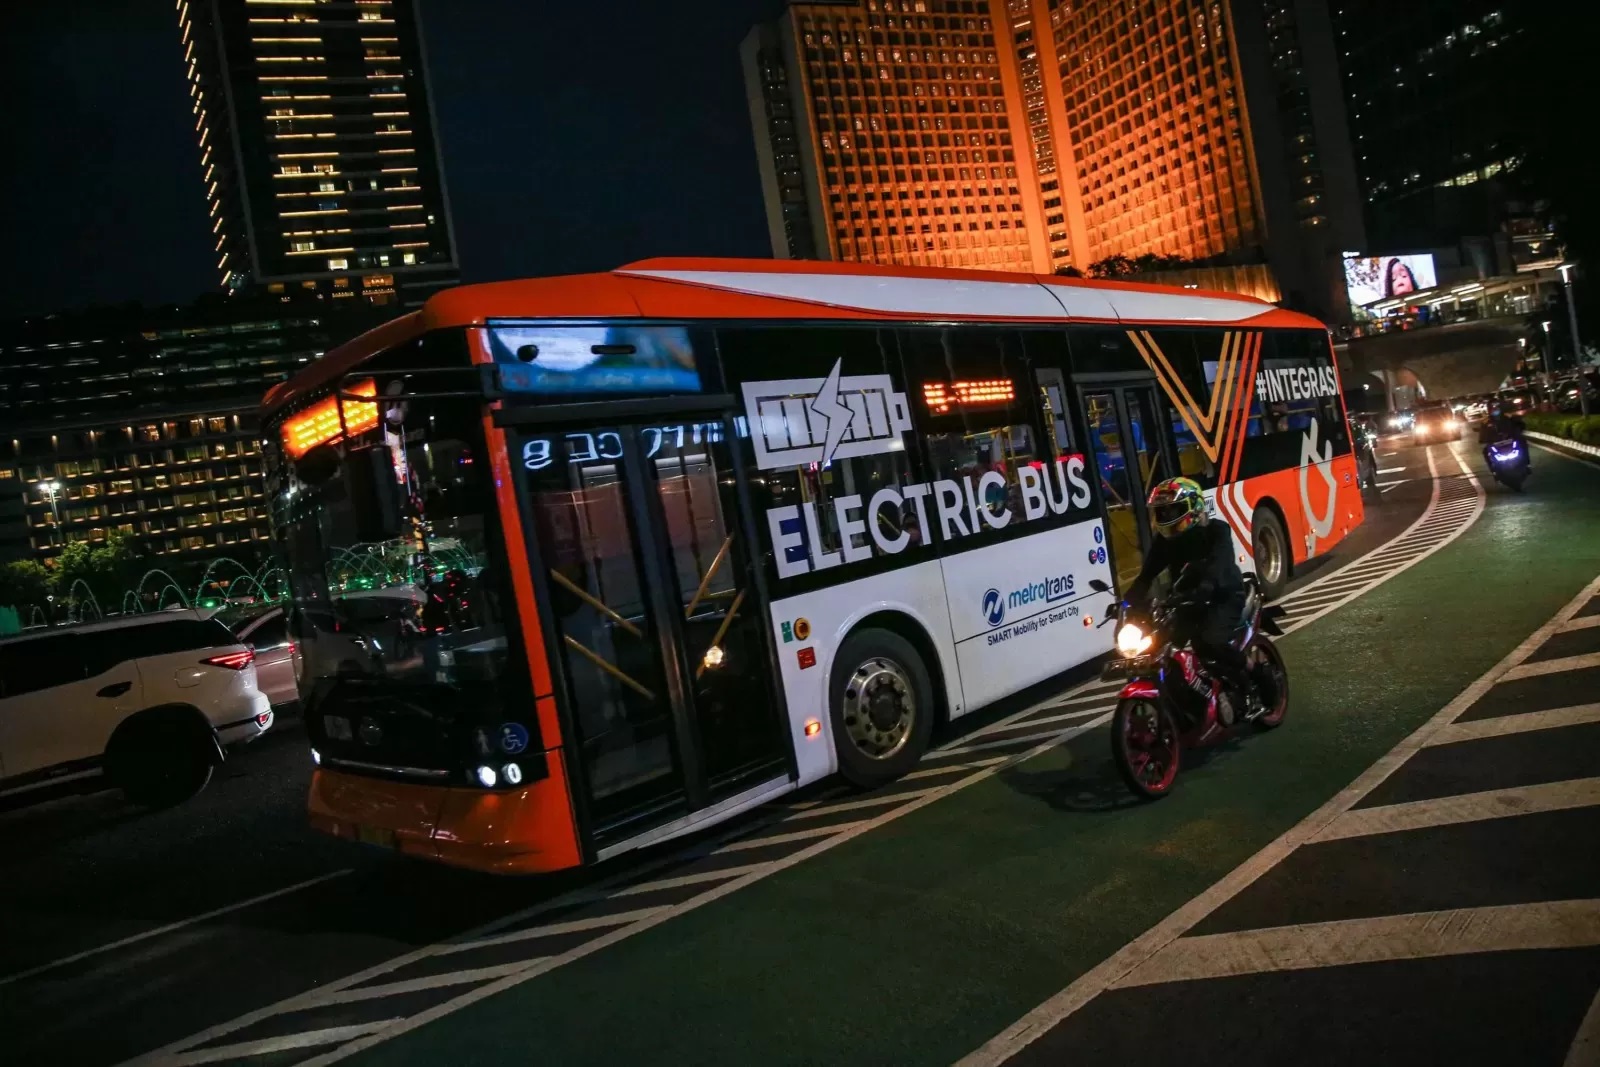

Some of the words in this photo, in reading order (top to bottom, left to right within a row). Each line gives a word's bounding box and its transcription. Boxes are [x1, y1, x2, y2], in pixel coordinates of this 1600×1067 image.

[1256, 366, 1340, 402] #INTEGRASI
[766, 471, 1012, 580] ELECTRIC
[1017, 458, 1092, 522] BUS
[1008, 573, 1075, 609] metrotrans
[987, 628, 1013, 646] SMART
[1013, 621, 1039, 637] Mobility
[1039, 617, 1048, 629] for
[1048, 609, 1068, 624] Smart
[1068, 605, 1080, 617] City
